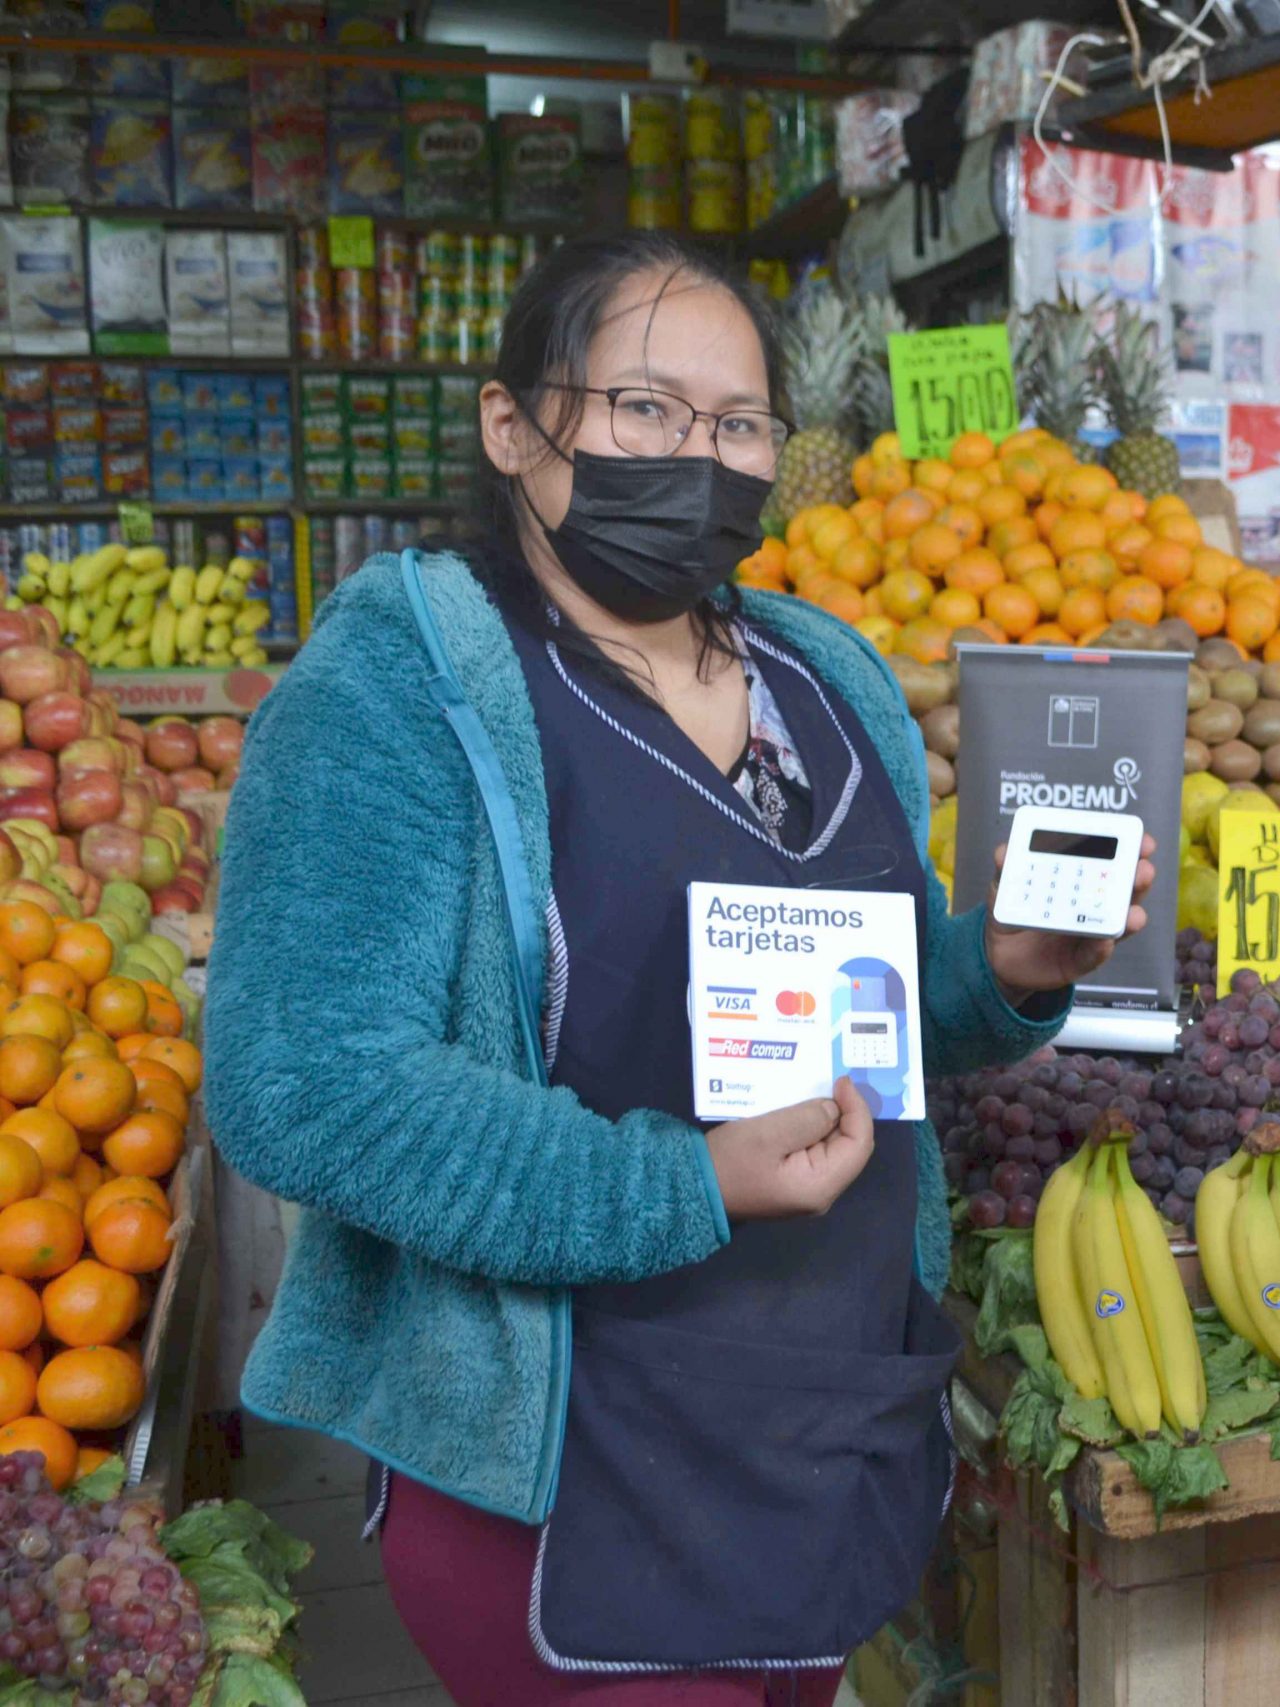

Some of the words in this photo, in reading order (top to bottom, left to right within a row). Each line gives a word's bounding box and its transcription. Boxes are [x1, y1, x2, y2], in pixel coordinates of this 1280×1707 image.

[1000, 781, 1128, 810] PRODEMU
[706, 896, 863, 929] Aceptamos
[705, 925, 816, 955] tarjetas
[715, 996, 751, 1010] VISA
[722, 1039, 750, 1058] Red
[750, 1042, 793, 1060] compra
